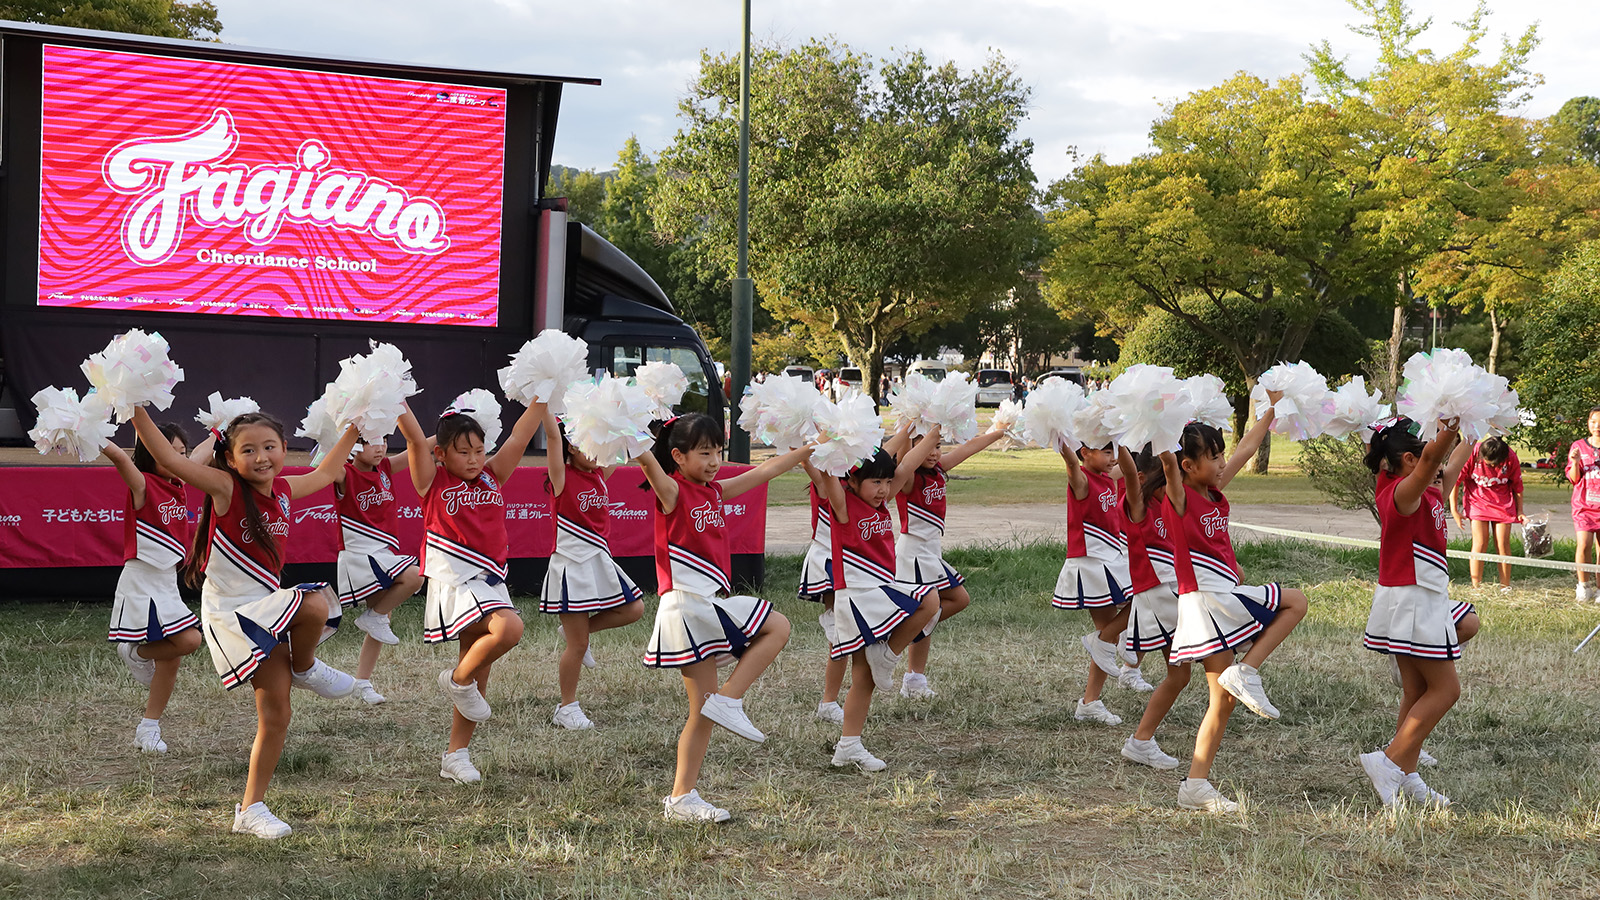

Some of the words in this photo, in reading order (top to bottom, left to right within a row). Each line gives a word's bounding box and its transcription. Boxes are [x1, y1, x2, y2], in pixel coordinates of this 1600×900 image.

[103, 108, 451, 266] Fagiano
[197, 249, 309, 269] Cheerdance
[315, 256, 377, 273] School
[42, 509, 124, 522] 子どもたちに
